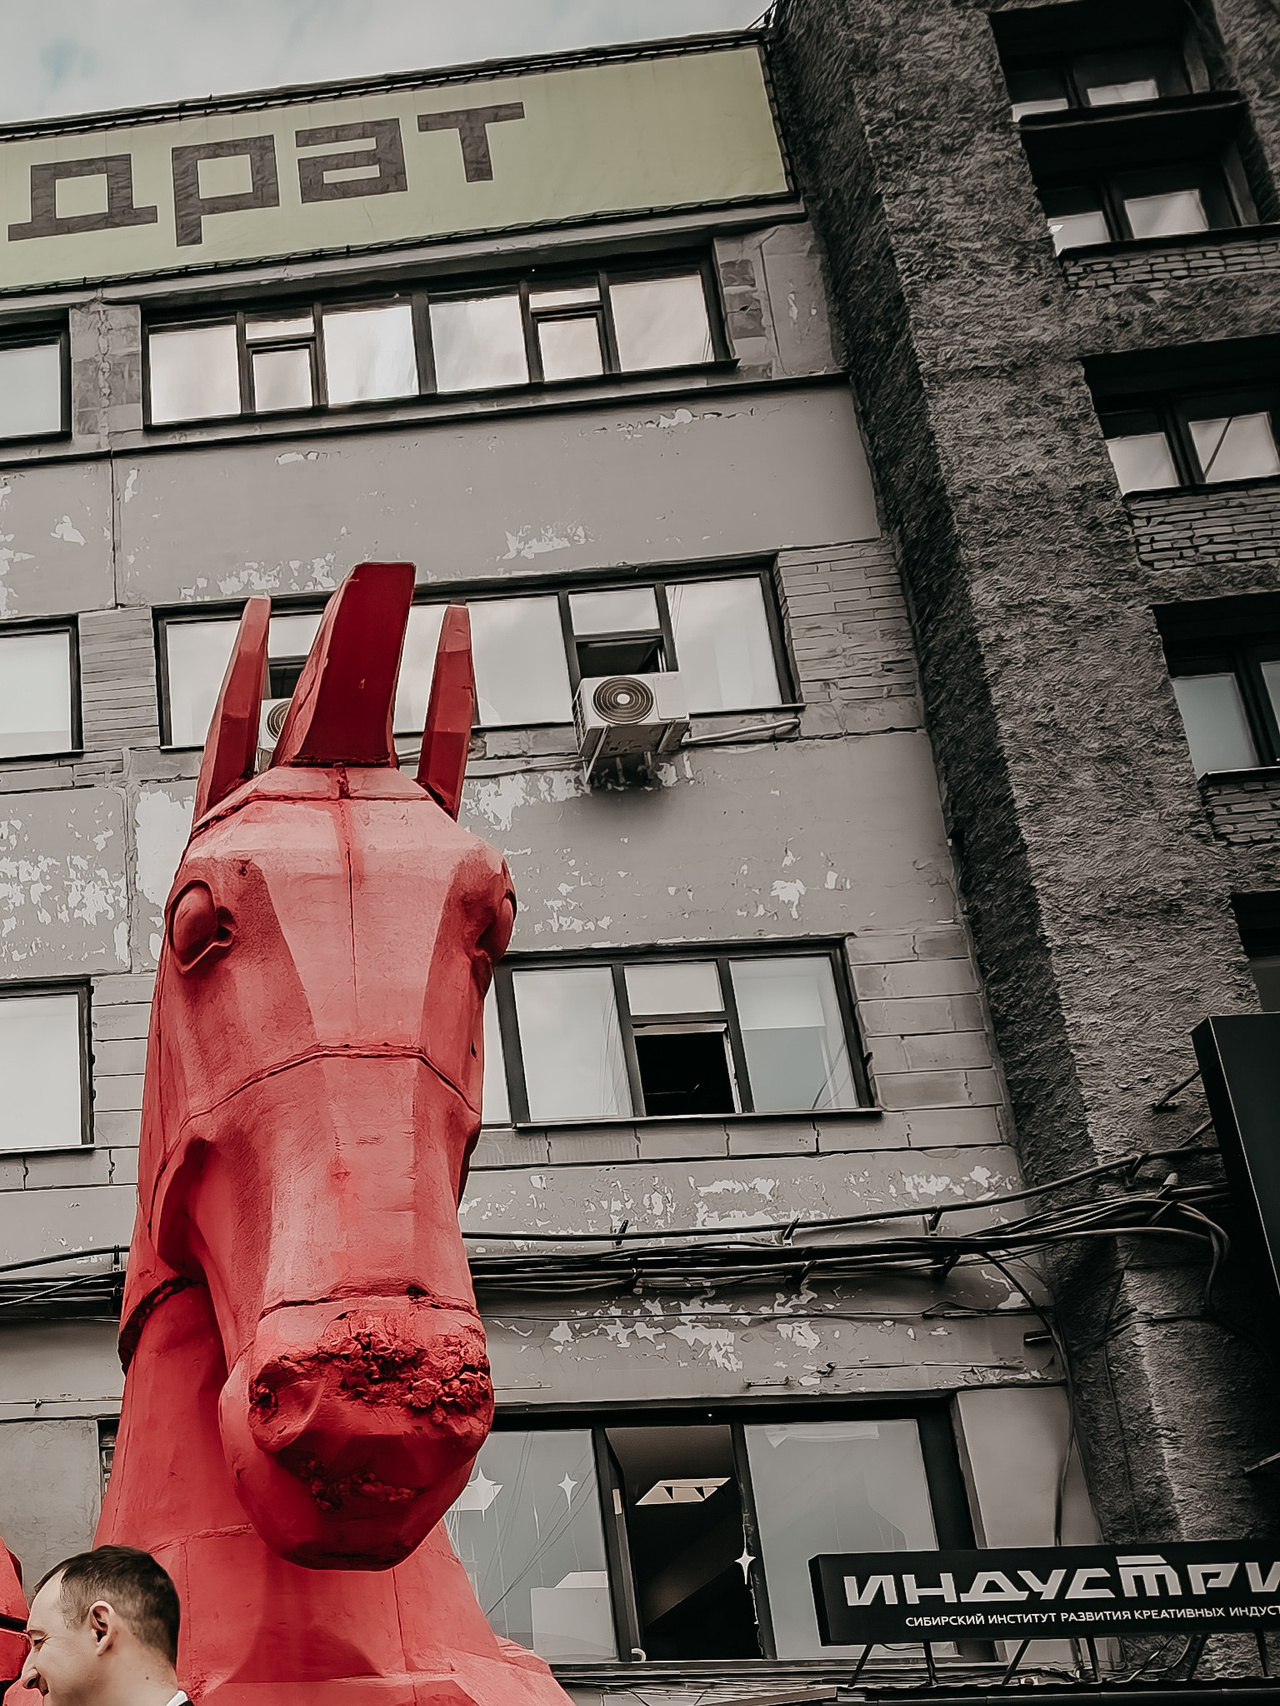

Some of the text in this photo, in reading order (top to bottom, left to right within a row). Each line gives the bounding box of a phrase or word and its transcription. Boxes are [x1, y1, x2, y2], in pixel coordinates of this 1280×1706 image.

[905, 1613, 985, 1627] СИБИРСКИЙ
[988, 1612, 1057, 1625] ИНСТИТУТ
[1060, 1610, 1132, 1622] РАЗВИТИЯ
[1134, 1607, 1226, 1620] КРЕАТИВНЫХ
